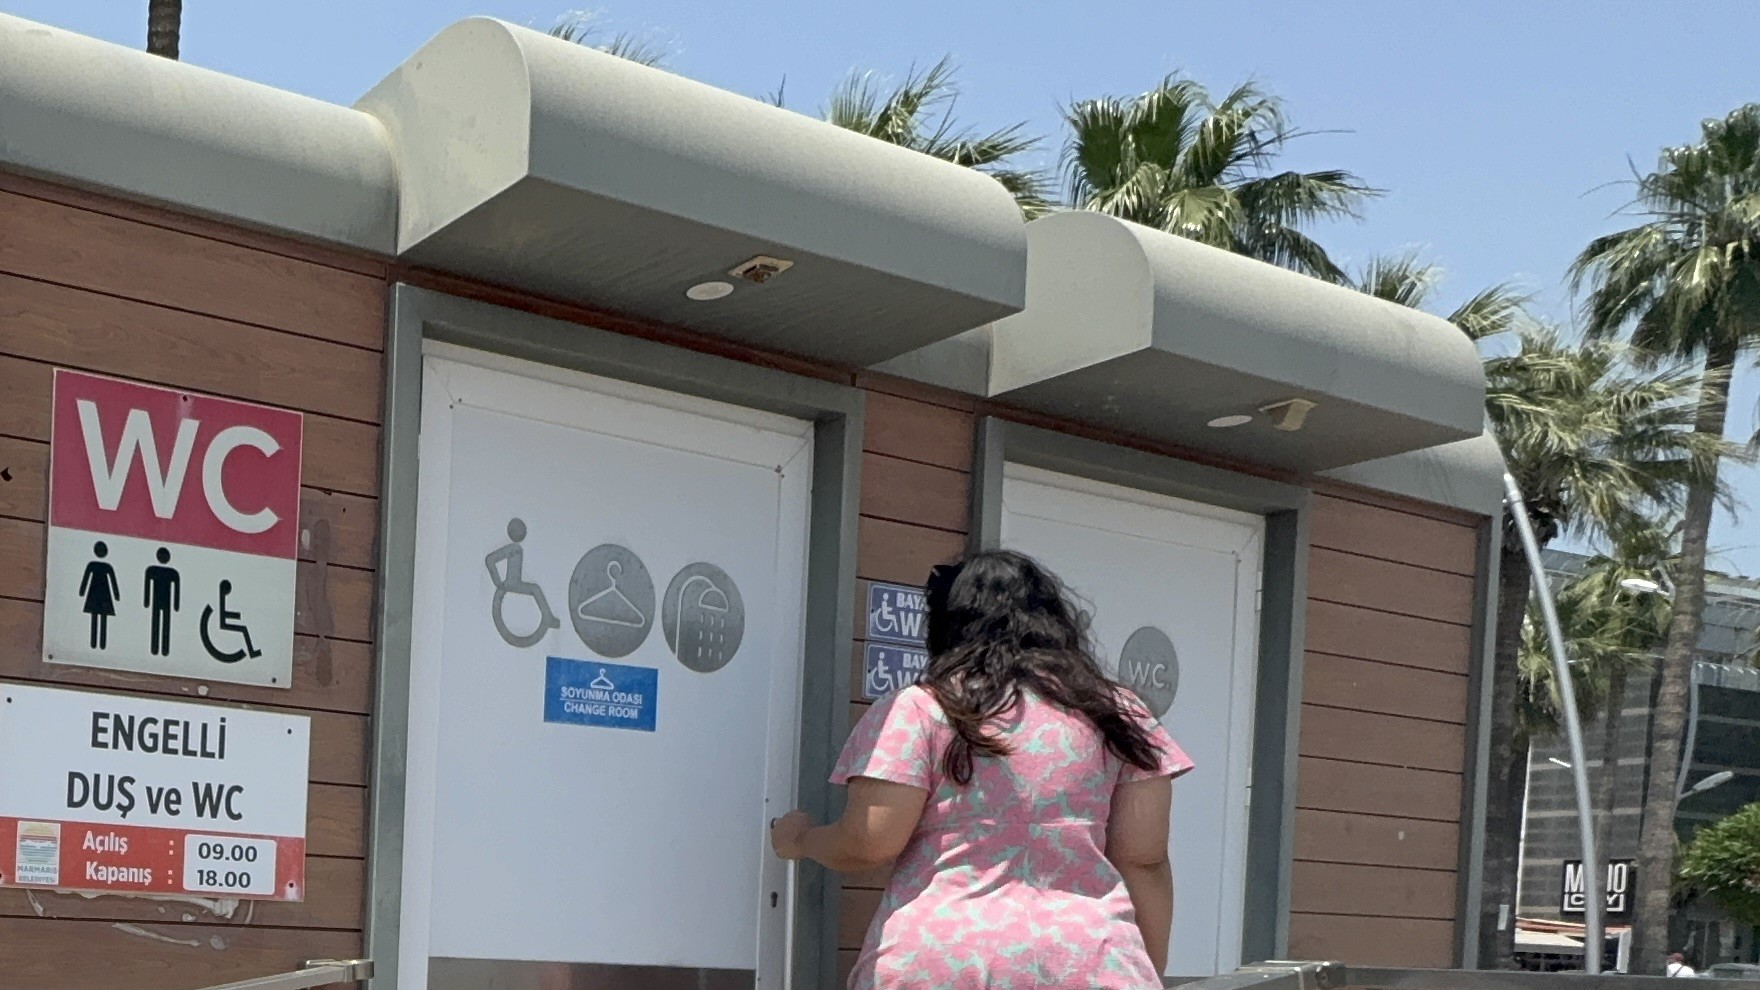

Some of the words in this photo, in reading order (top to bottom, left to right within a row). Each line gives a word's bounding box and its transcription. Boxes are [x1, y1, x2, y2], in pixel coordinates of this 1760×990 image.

[76, 398, 282, 534] WC
[560, 686, 610, 702] SOYUNMA
[612, 692, 643, 704] ODASI
[564, 702, 606, 716] CHANGE
[608, 706, 638, 719] ROOM
[90, 711, 227, 760] ENGELLİ
[66, 771, 136, 819] DUŞ
[145, 785, 182, 816] ve
[191, 781, 244, 821] WC
[82, 830, 129, 856] Açılış
[197, 842, 258, 863] 09.00
[85, 860, 153, 886] Kapanış
[196, 869, 252, 889] 18.00
